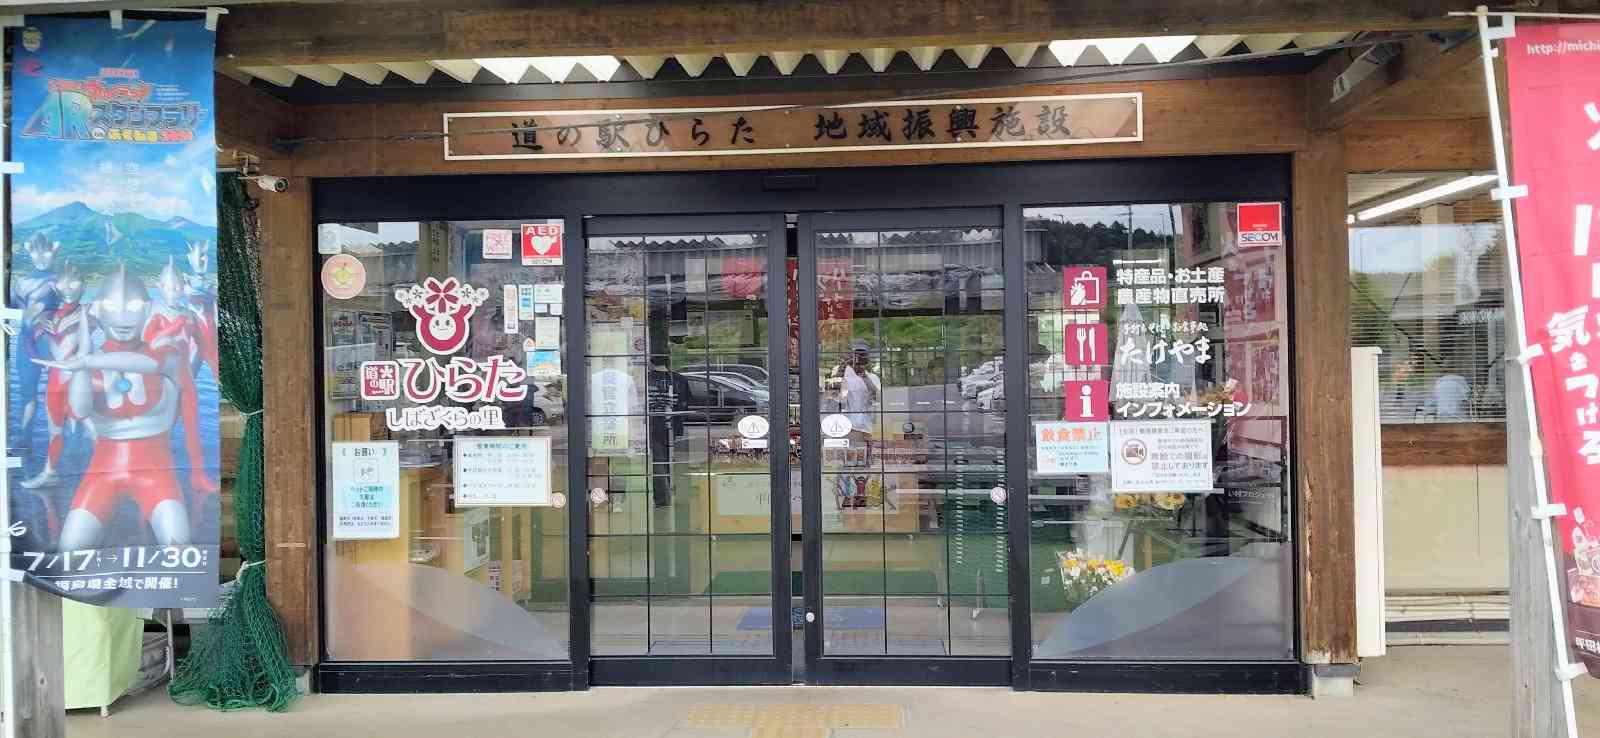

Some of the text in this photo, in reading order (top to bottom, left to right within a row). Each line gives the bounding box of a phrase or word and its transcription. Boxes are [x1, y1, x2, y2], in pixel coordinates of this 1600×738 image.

[20, 89, 92, 140] AR
[511, 104, 1073, 150] 道の駅ひらた 地域振興施設
[525, 225, 559, 235] AED
[1241, 232, 1279, 241] SECOM
[1117, 267, 1225, 285] 特産品・お土産
[1117, 286, 1225, 305] 農産物直売所
[1119, 336, 1213, 365] たけやま
[401, 355, 528, 403] ひらた
[1116, 382, 1180, 399] 施設案内
[385, 406, 505, 431] しばざくらの里
[1116, 401, 1252, 417] インフォメーション
[24, 546, 202, 571] 7/17 11/30
